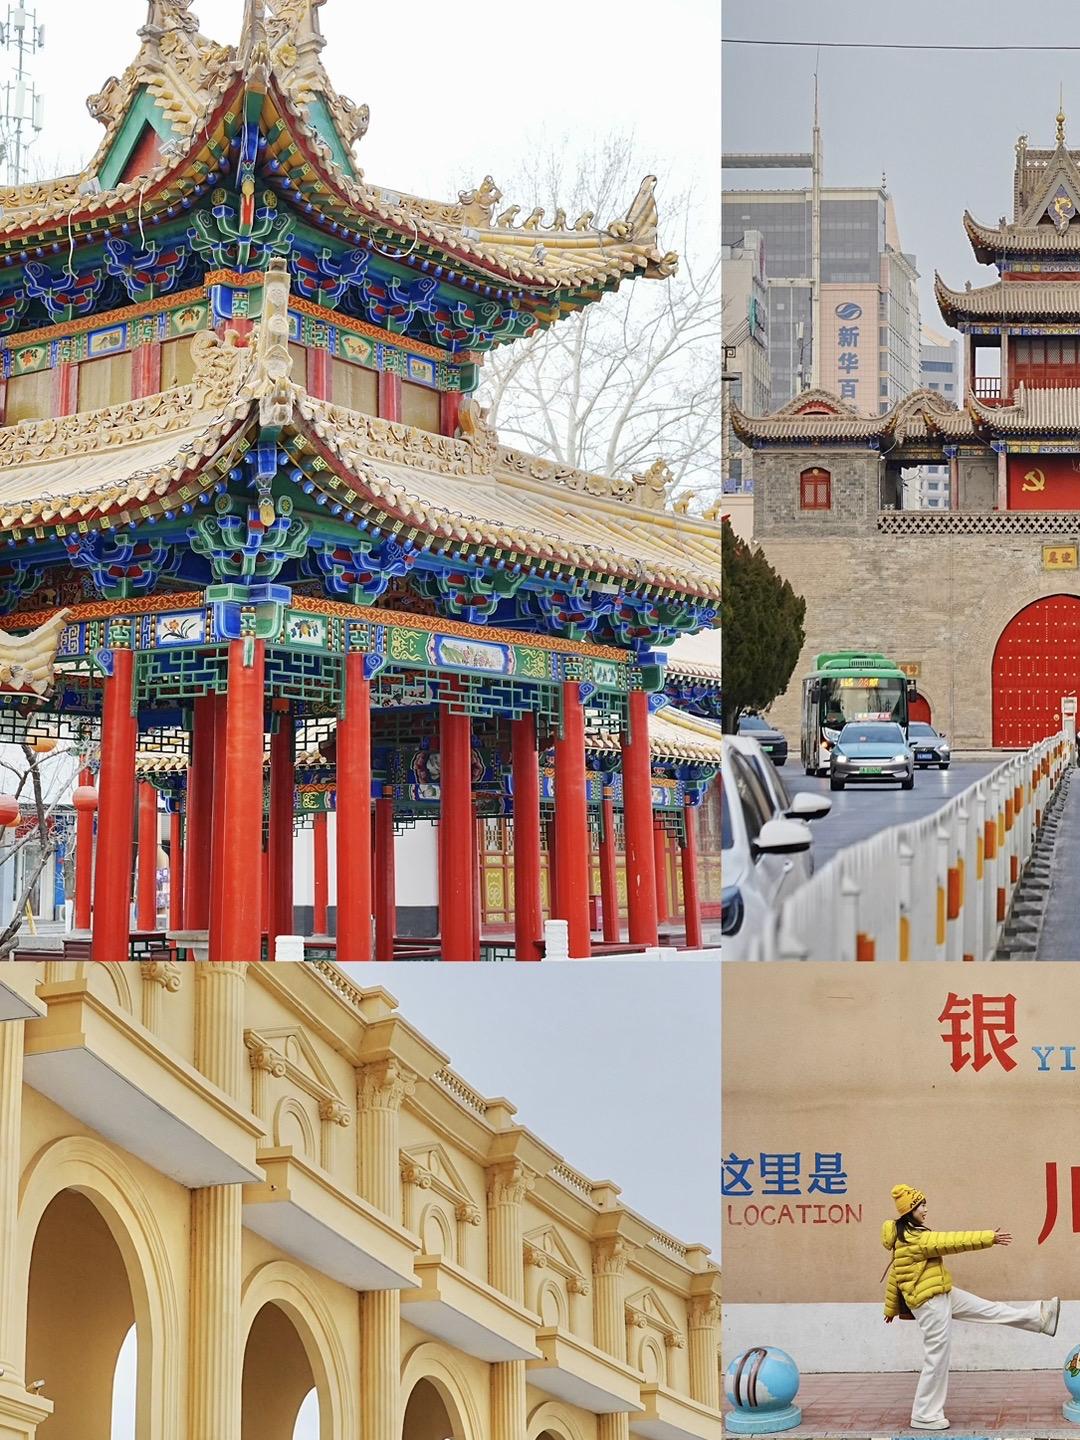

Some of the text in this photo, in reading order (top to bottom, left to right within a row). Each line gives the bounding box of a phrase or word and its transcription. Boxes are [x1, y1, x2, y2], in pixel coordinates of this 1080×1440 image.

[838, 325, 859, 399] 新华百
[937, 992, 1018, 1073] 银
[721, 1152, 848, 1196] 这里是
[727, 1203, 863, 1226] LOCATION
